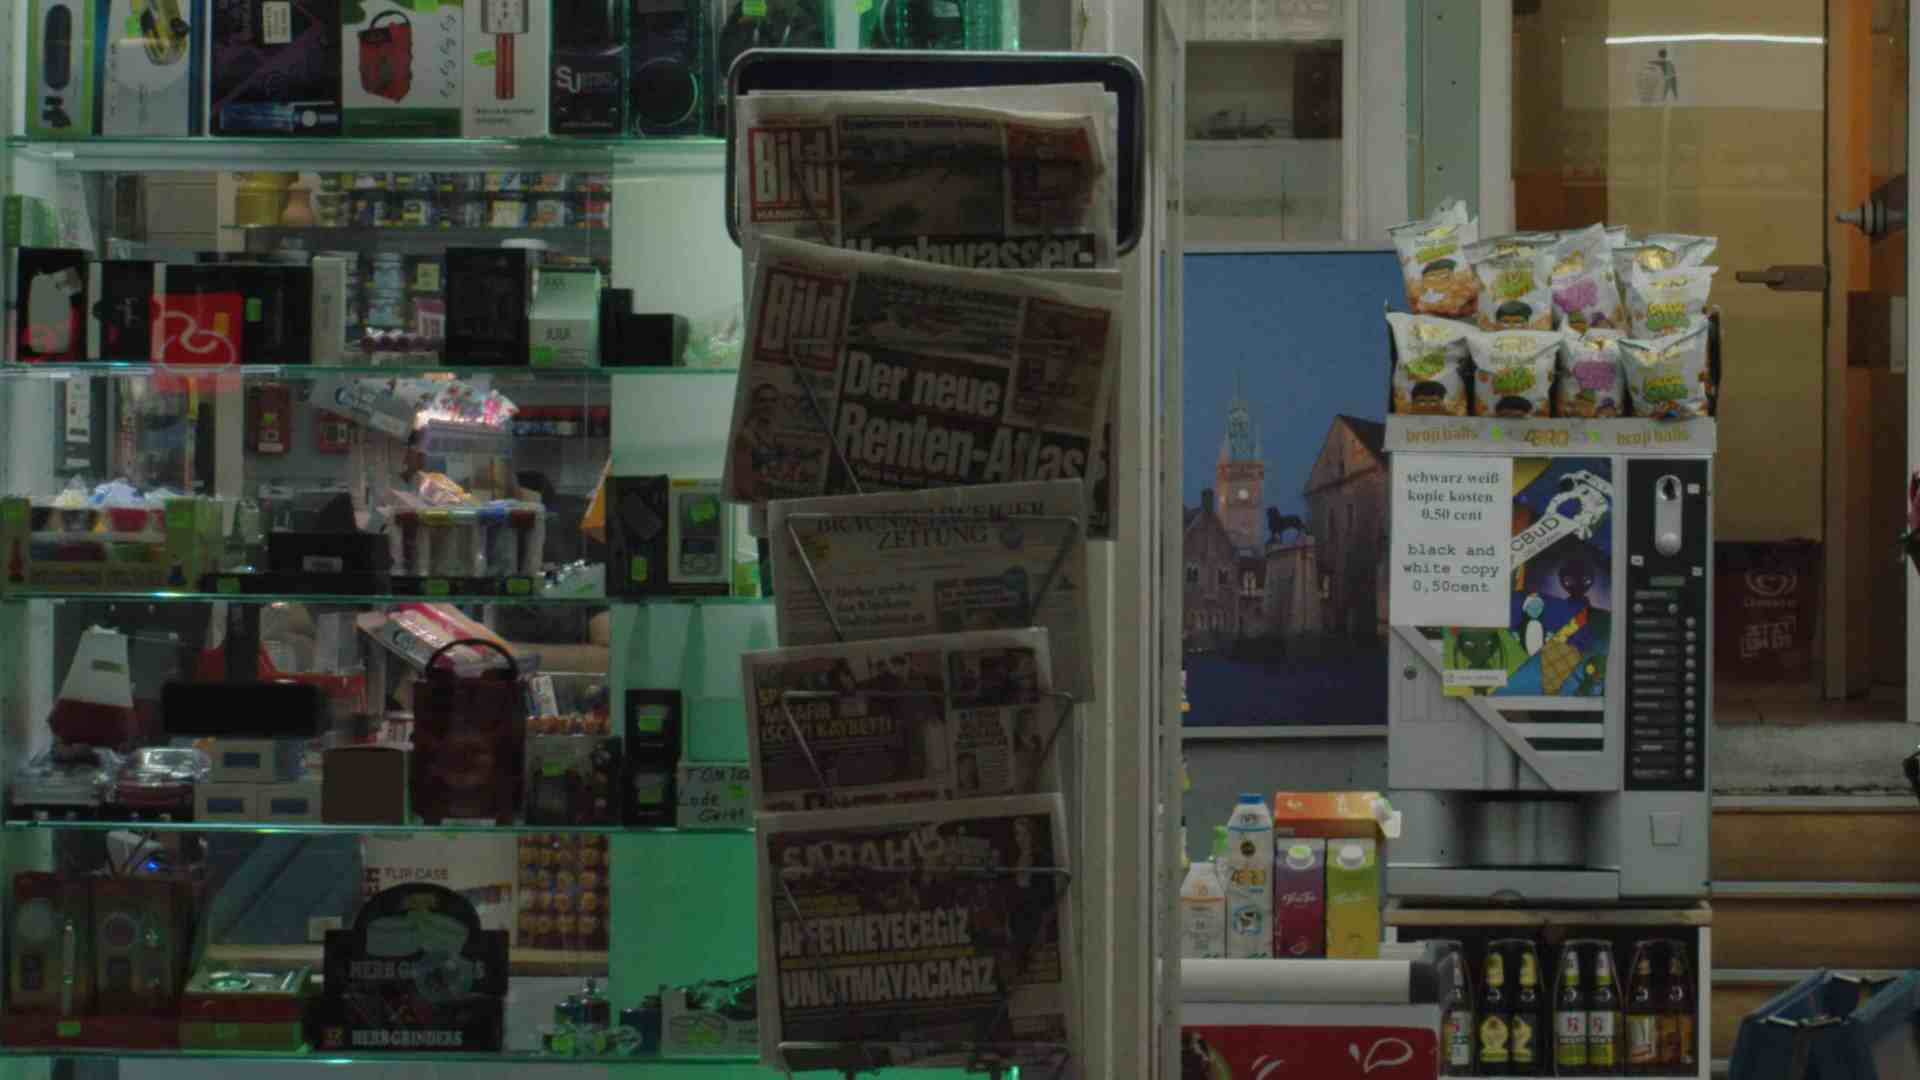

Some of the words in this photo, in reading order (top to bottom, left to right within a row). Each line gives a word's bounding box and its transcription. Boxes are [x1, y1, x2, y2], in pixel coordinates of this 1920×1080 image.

[756, 129, 828, 203] Bild
[762, 273, 844, 357] Bild
[844, 350, 908, 402] Der
[911, 367, 1000, 417] neue
[1407, 471, 1463, 484] schwarz
[1467, 471, 1499, 484] weiß
[1407, 490, 1445, 504] kopie
[1449, 489, 1494, 503] kosten
[1453, 509, 1483, 521] cent
[877, 525, 988, 551] ZEITUNG
[1407, 544, 1456, 556] black
[1465, 544, 1496, 556] and
[1402, 561, 1451, 574] white
[1460, 564, 1499, 578] copy
